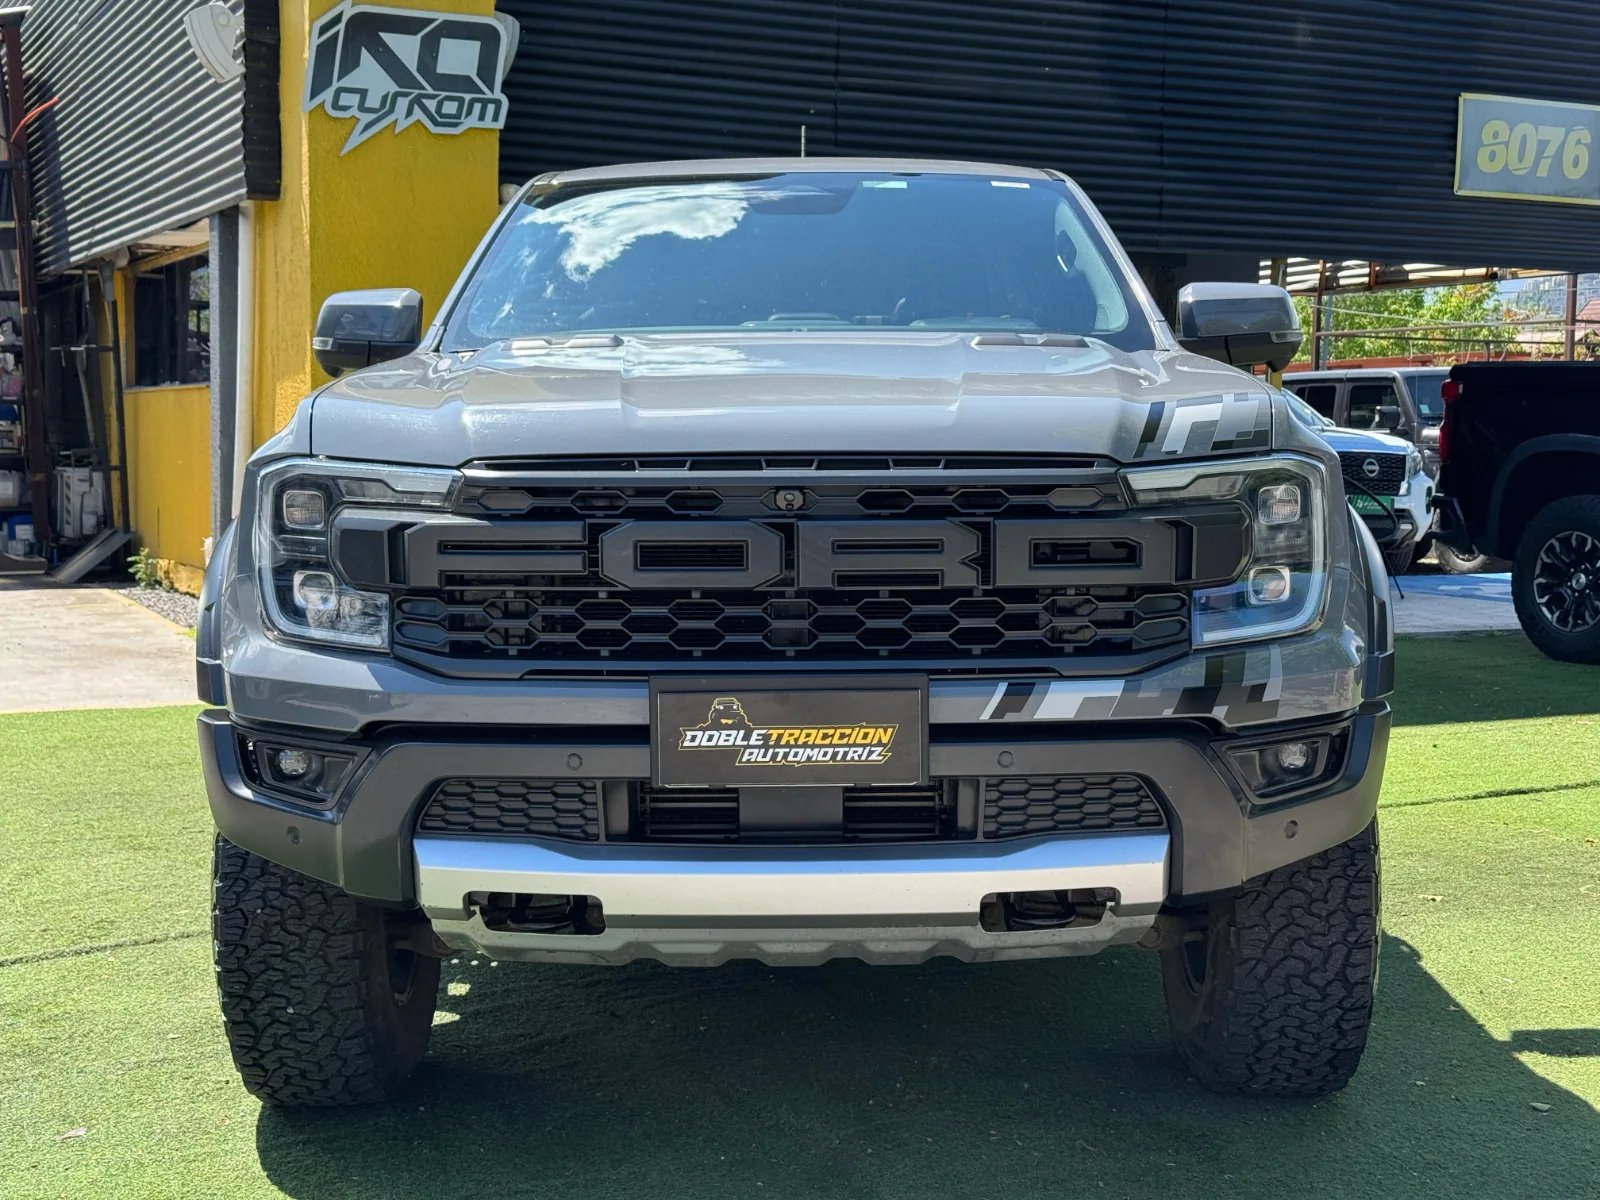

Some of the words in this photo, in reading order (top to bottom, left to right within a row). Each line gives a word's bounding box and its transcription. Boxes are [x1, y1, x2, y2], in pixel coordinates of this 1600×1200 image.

[1476, 119, 1591, 180] 8076
[404, 518, 1177, 590] FORD
[741, 747, 884, 763] AUTOMOTRIZ
